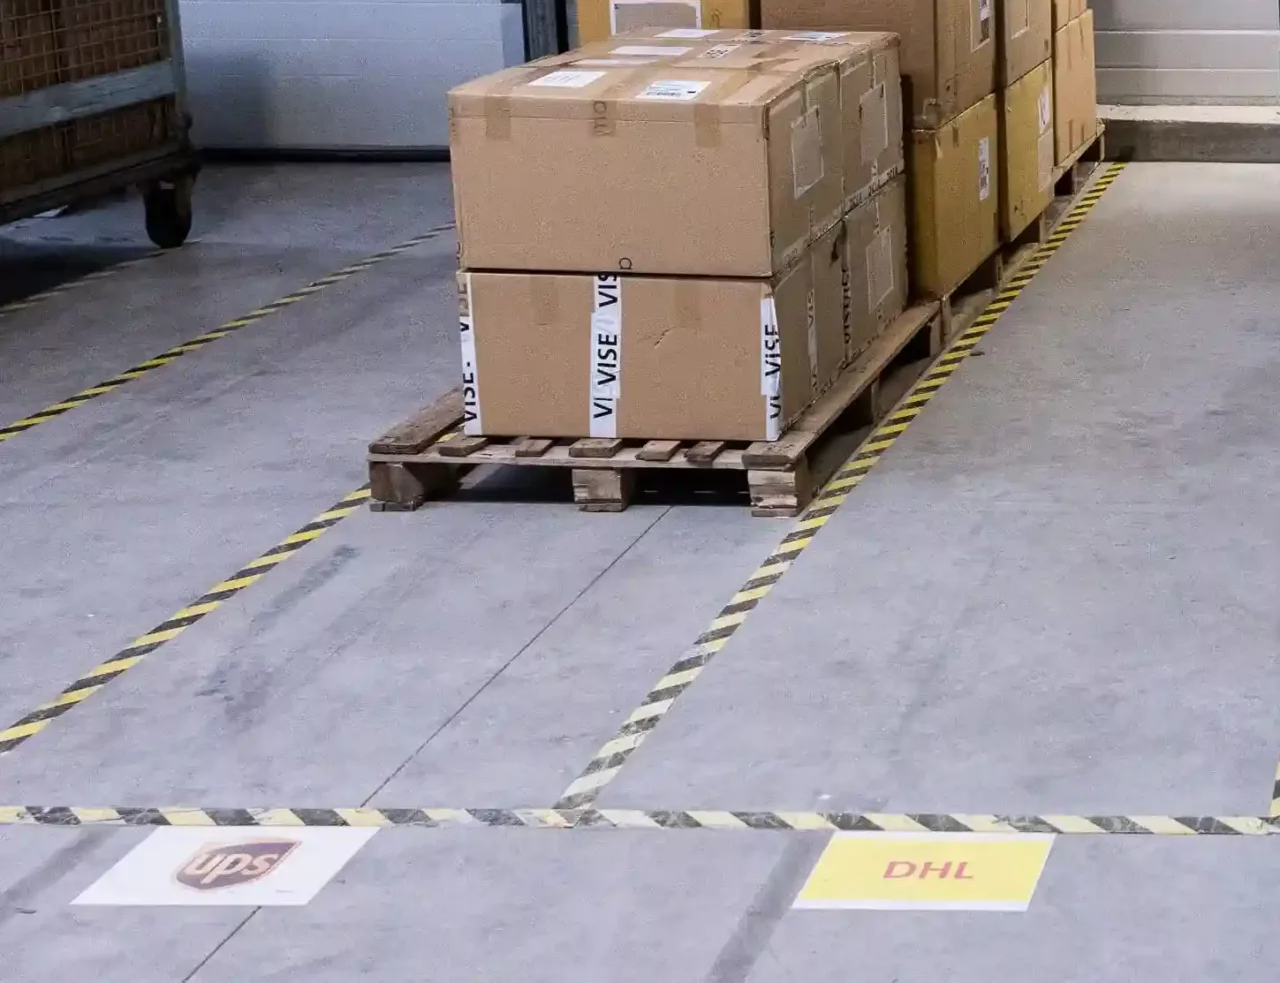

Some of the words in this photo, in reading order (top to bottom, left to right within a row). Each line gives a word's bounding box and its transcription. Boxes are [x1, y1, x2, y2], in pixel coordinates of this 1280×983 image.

[598, 273, 618, 308] VIS
[597, 333, 618, 386] VISE
[593, 397, 614, 419] VI
[184, 853, 279, 885] ups
[883, 861, 974, 879] DHL
